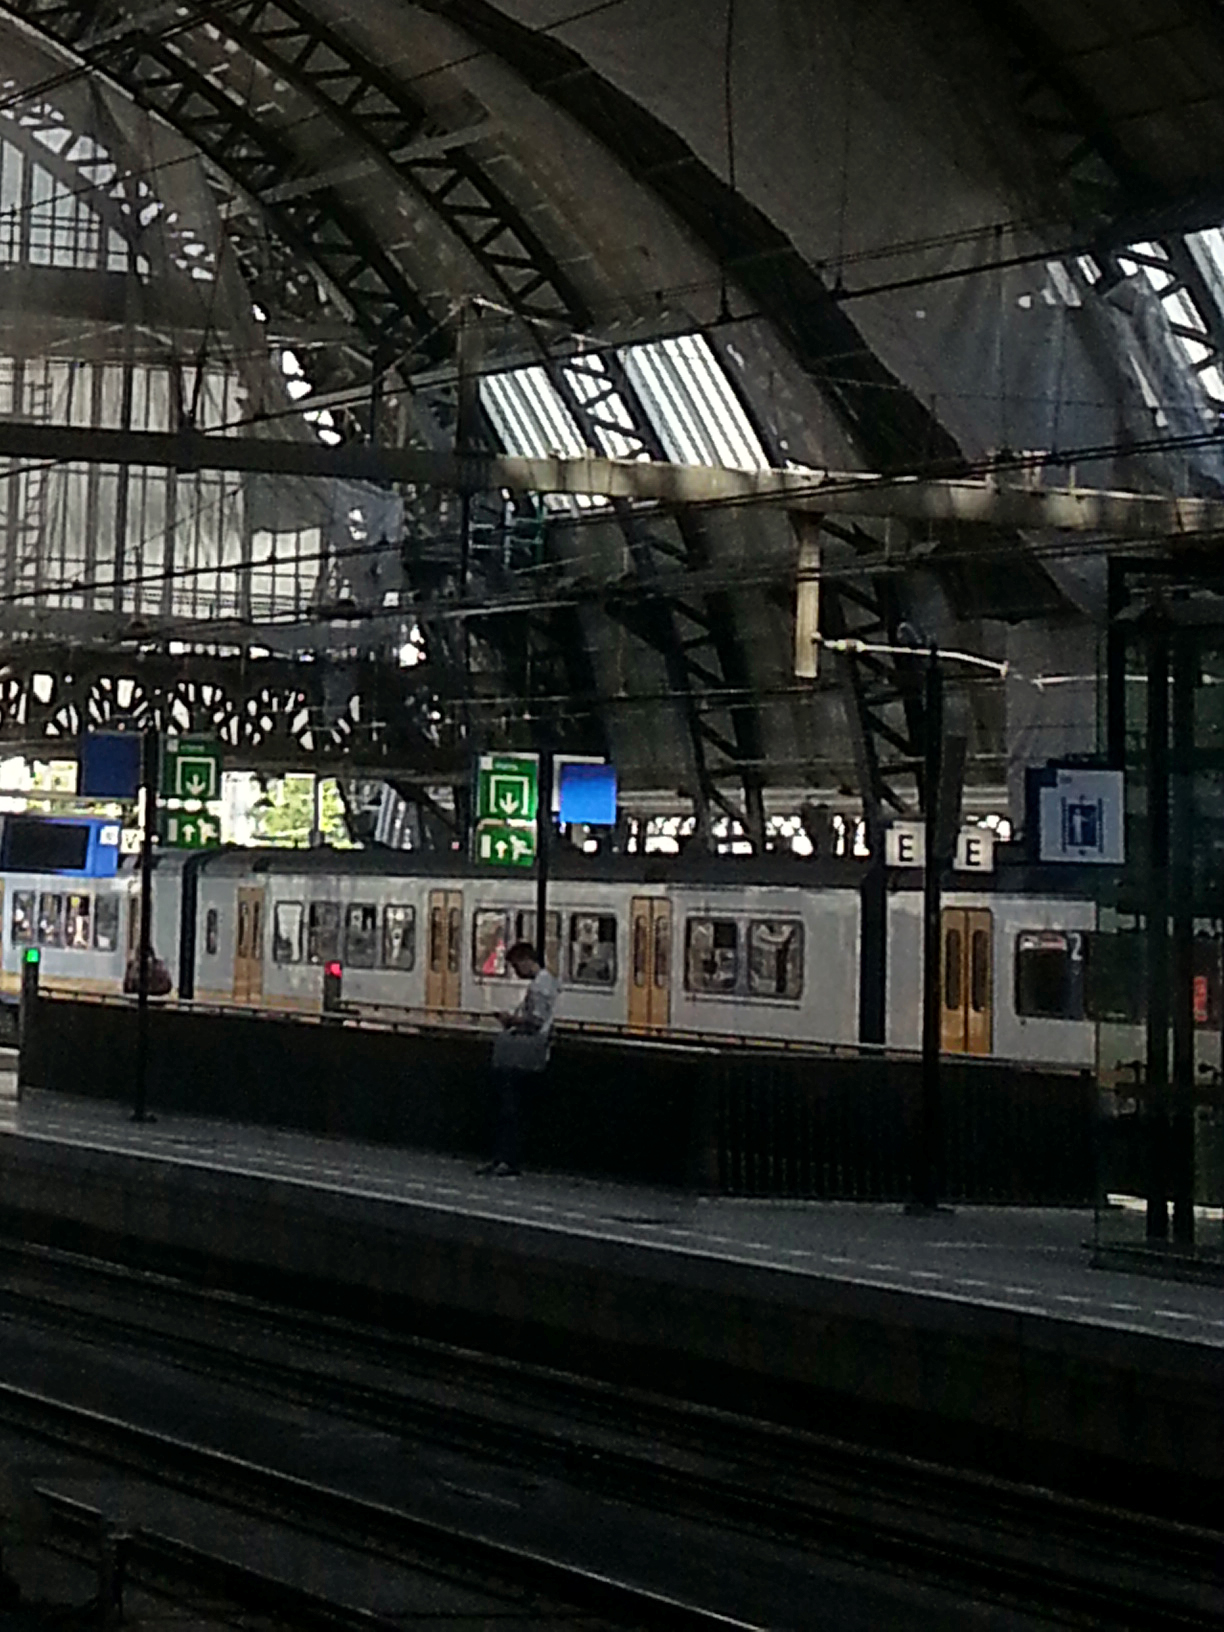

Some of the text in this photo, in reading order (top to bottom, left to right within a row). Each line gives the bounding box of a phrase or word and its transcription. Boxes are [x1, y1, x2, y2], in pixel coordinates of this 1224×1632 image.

[898, 834, 914, 862] E
[965, 838, 981, 866] E
[1068, 933, 1082, 961] 2
